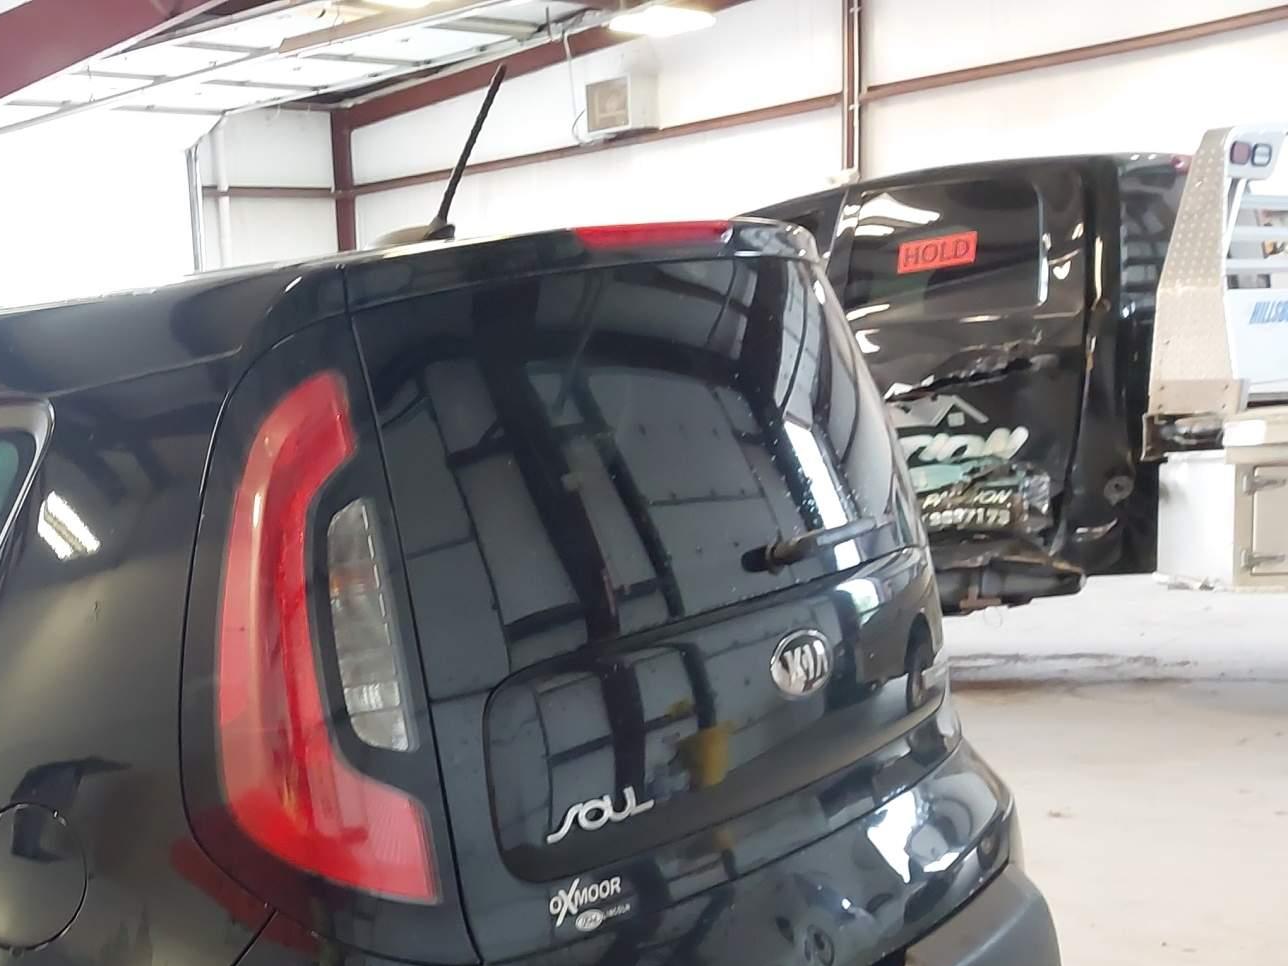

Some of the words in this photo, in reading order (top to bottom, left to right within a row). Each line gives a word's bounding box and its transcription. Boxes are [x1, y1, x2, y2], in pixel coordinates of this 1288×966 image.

[903, 239, 970, 268] HOLD
[781, 639, 829, 690] KIA
[546, 785, 655, 844] SOUL
